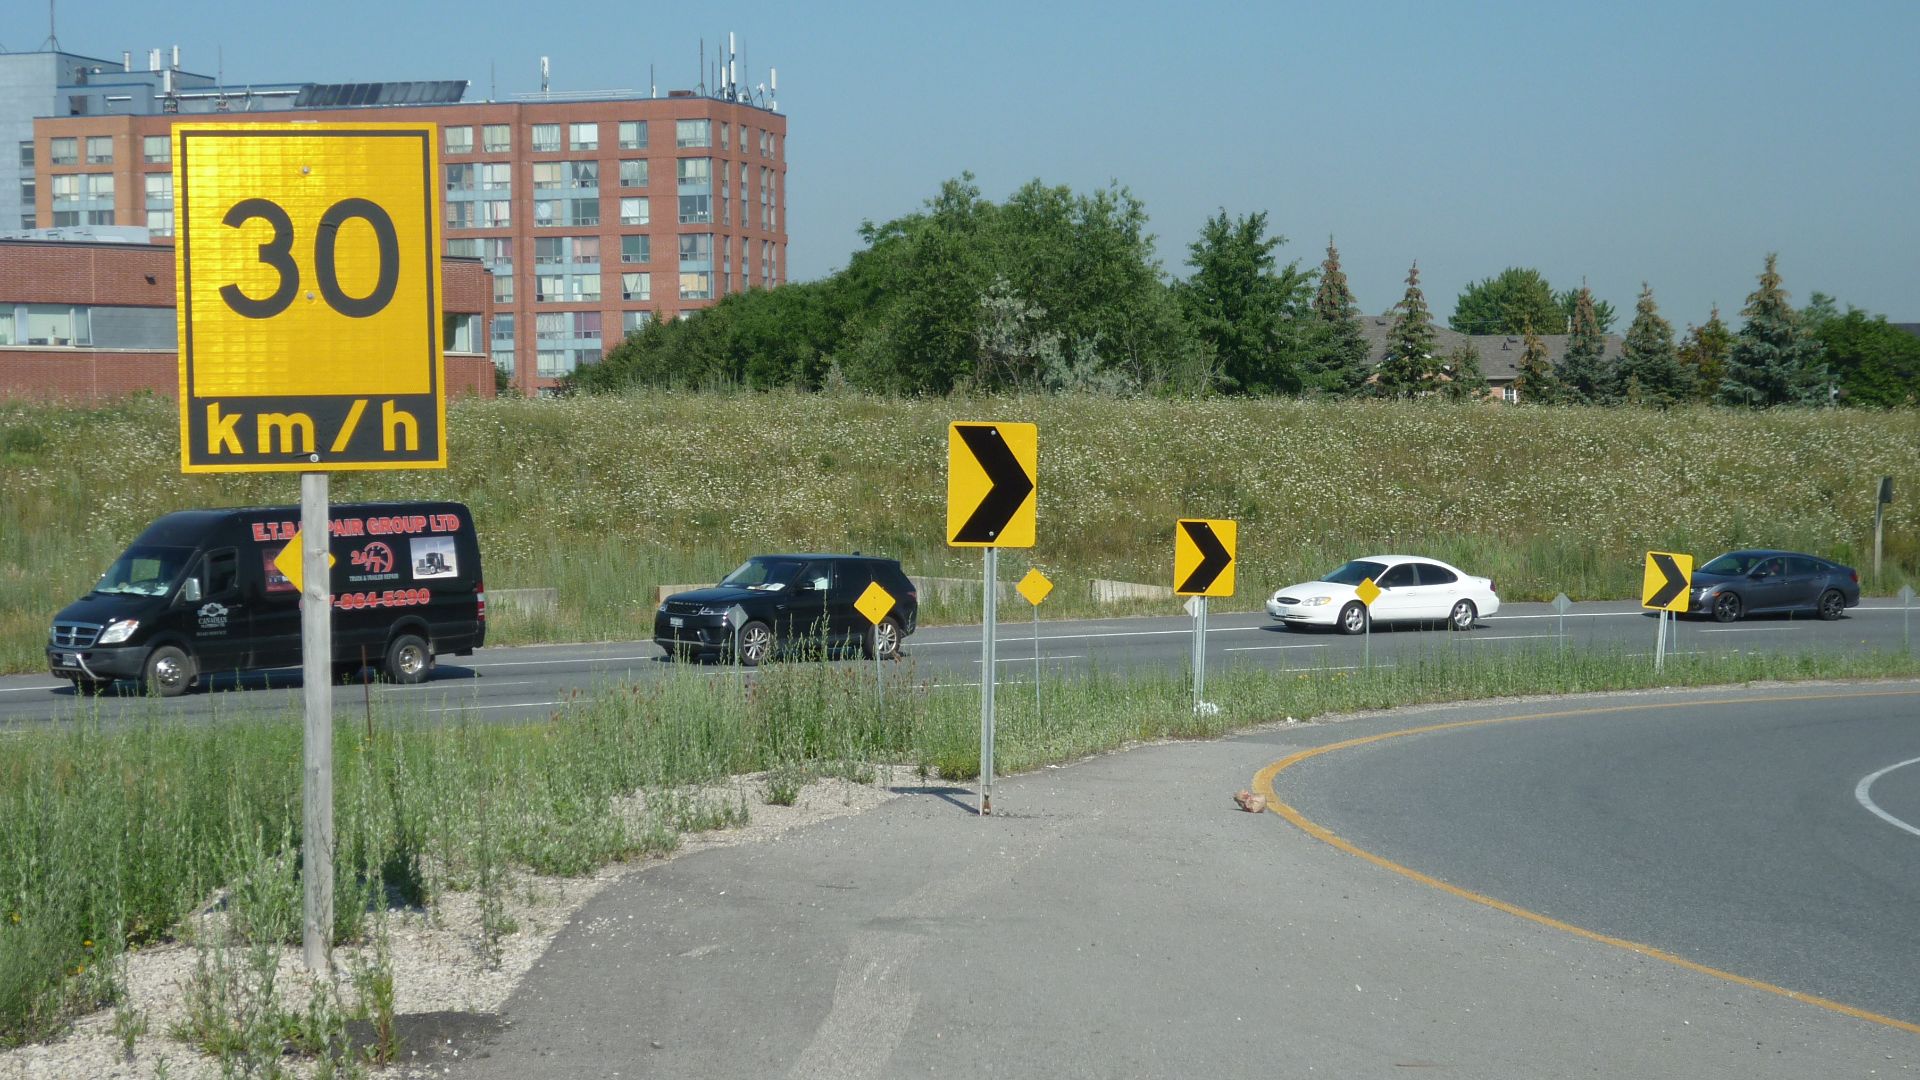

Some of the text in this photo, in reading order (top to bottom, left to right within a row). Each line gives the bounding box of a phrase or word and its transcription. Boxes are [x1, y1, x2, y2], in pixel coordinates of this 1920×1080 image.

[218, 197, 400, 319] 30
[206, 399, 418, 455] km/h
[298, 518, 365, 537] PAIR
[367, 515, 426, 535] GROUP
[429, 513, 460, 532] LTD
